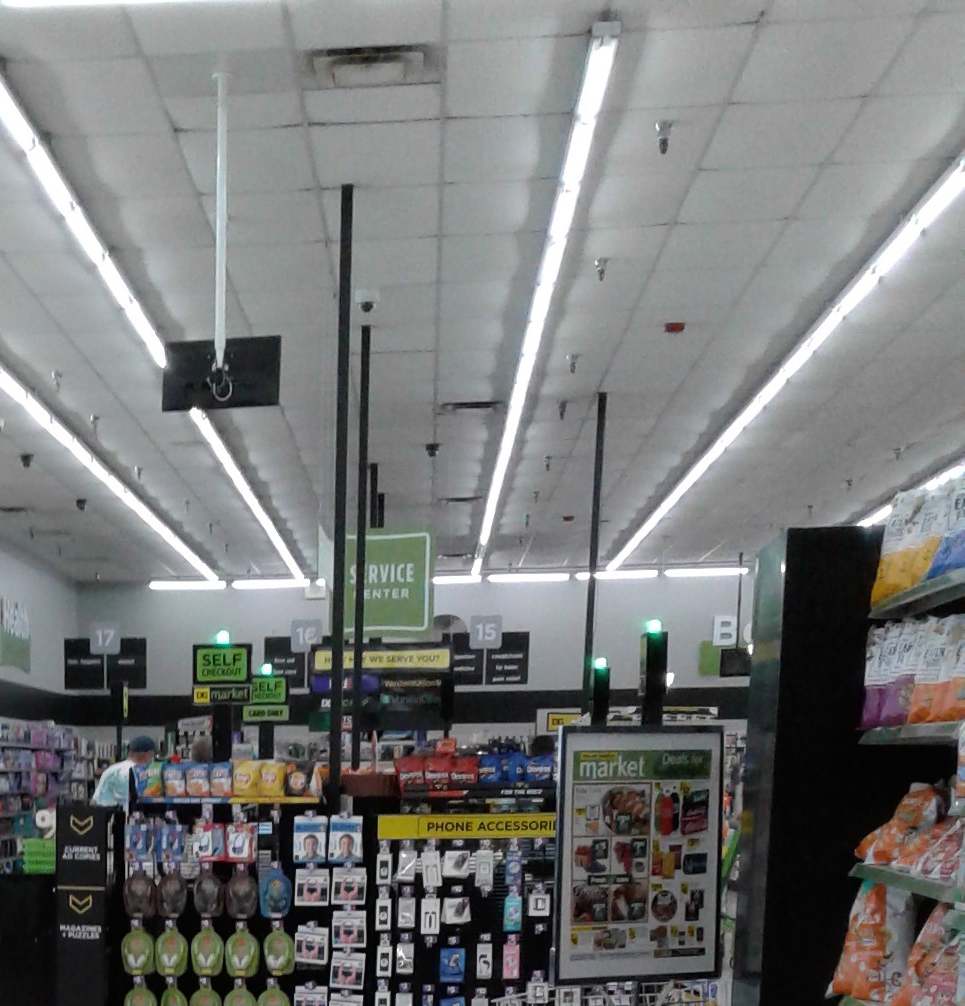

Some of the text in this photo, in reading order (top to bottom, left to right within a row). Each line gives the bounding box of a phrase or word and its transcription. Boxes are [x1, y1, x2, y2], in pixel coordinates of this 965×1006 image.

[349, 563, 414, 583] SRVICE
[354, 588, 410, 599] ENTER
[95, 629, 115, 646] 17
[476, 623, 496, 641] 15
[202, 653, 242, 666] SELF
[202, 668, 242, 677] CHECKOUT
[211, 687, 248, 700] market
[579, 755, 645, 779] market
[427, 820, 556, 832] PHONE ACCESSORI
[59, 924, 102, 932] MAGAZINES
